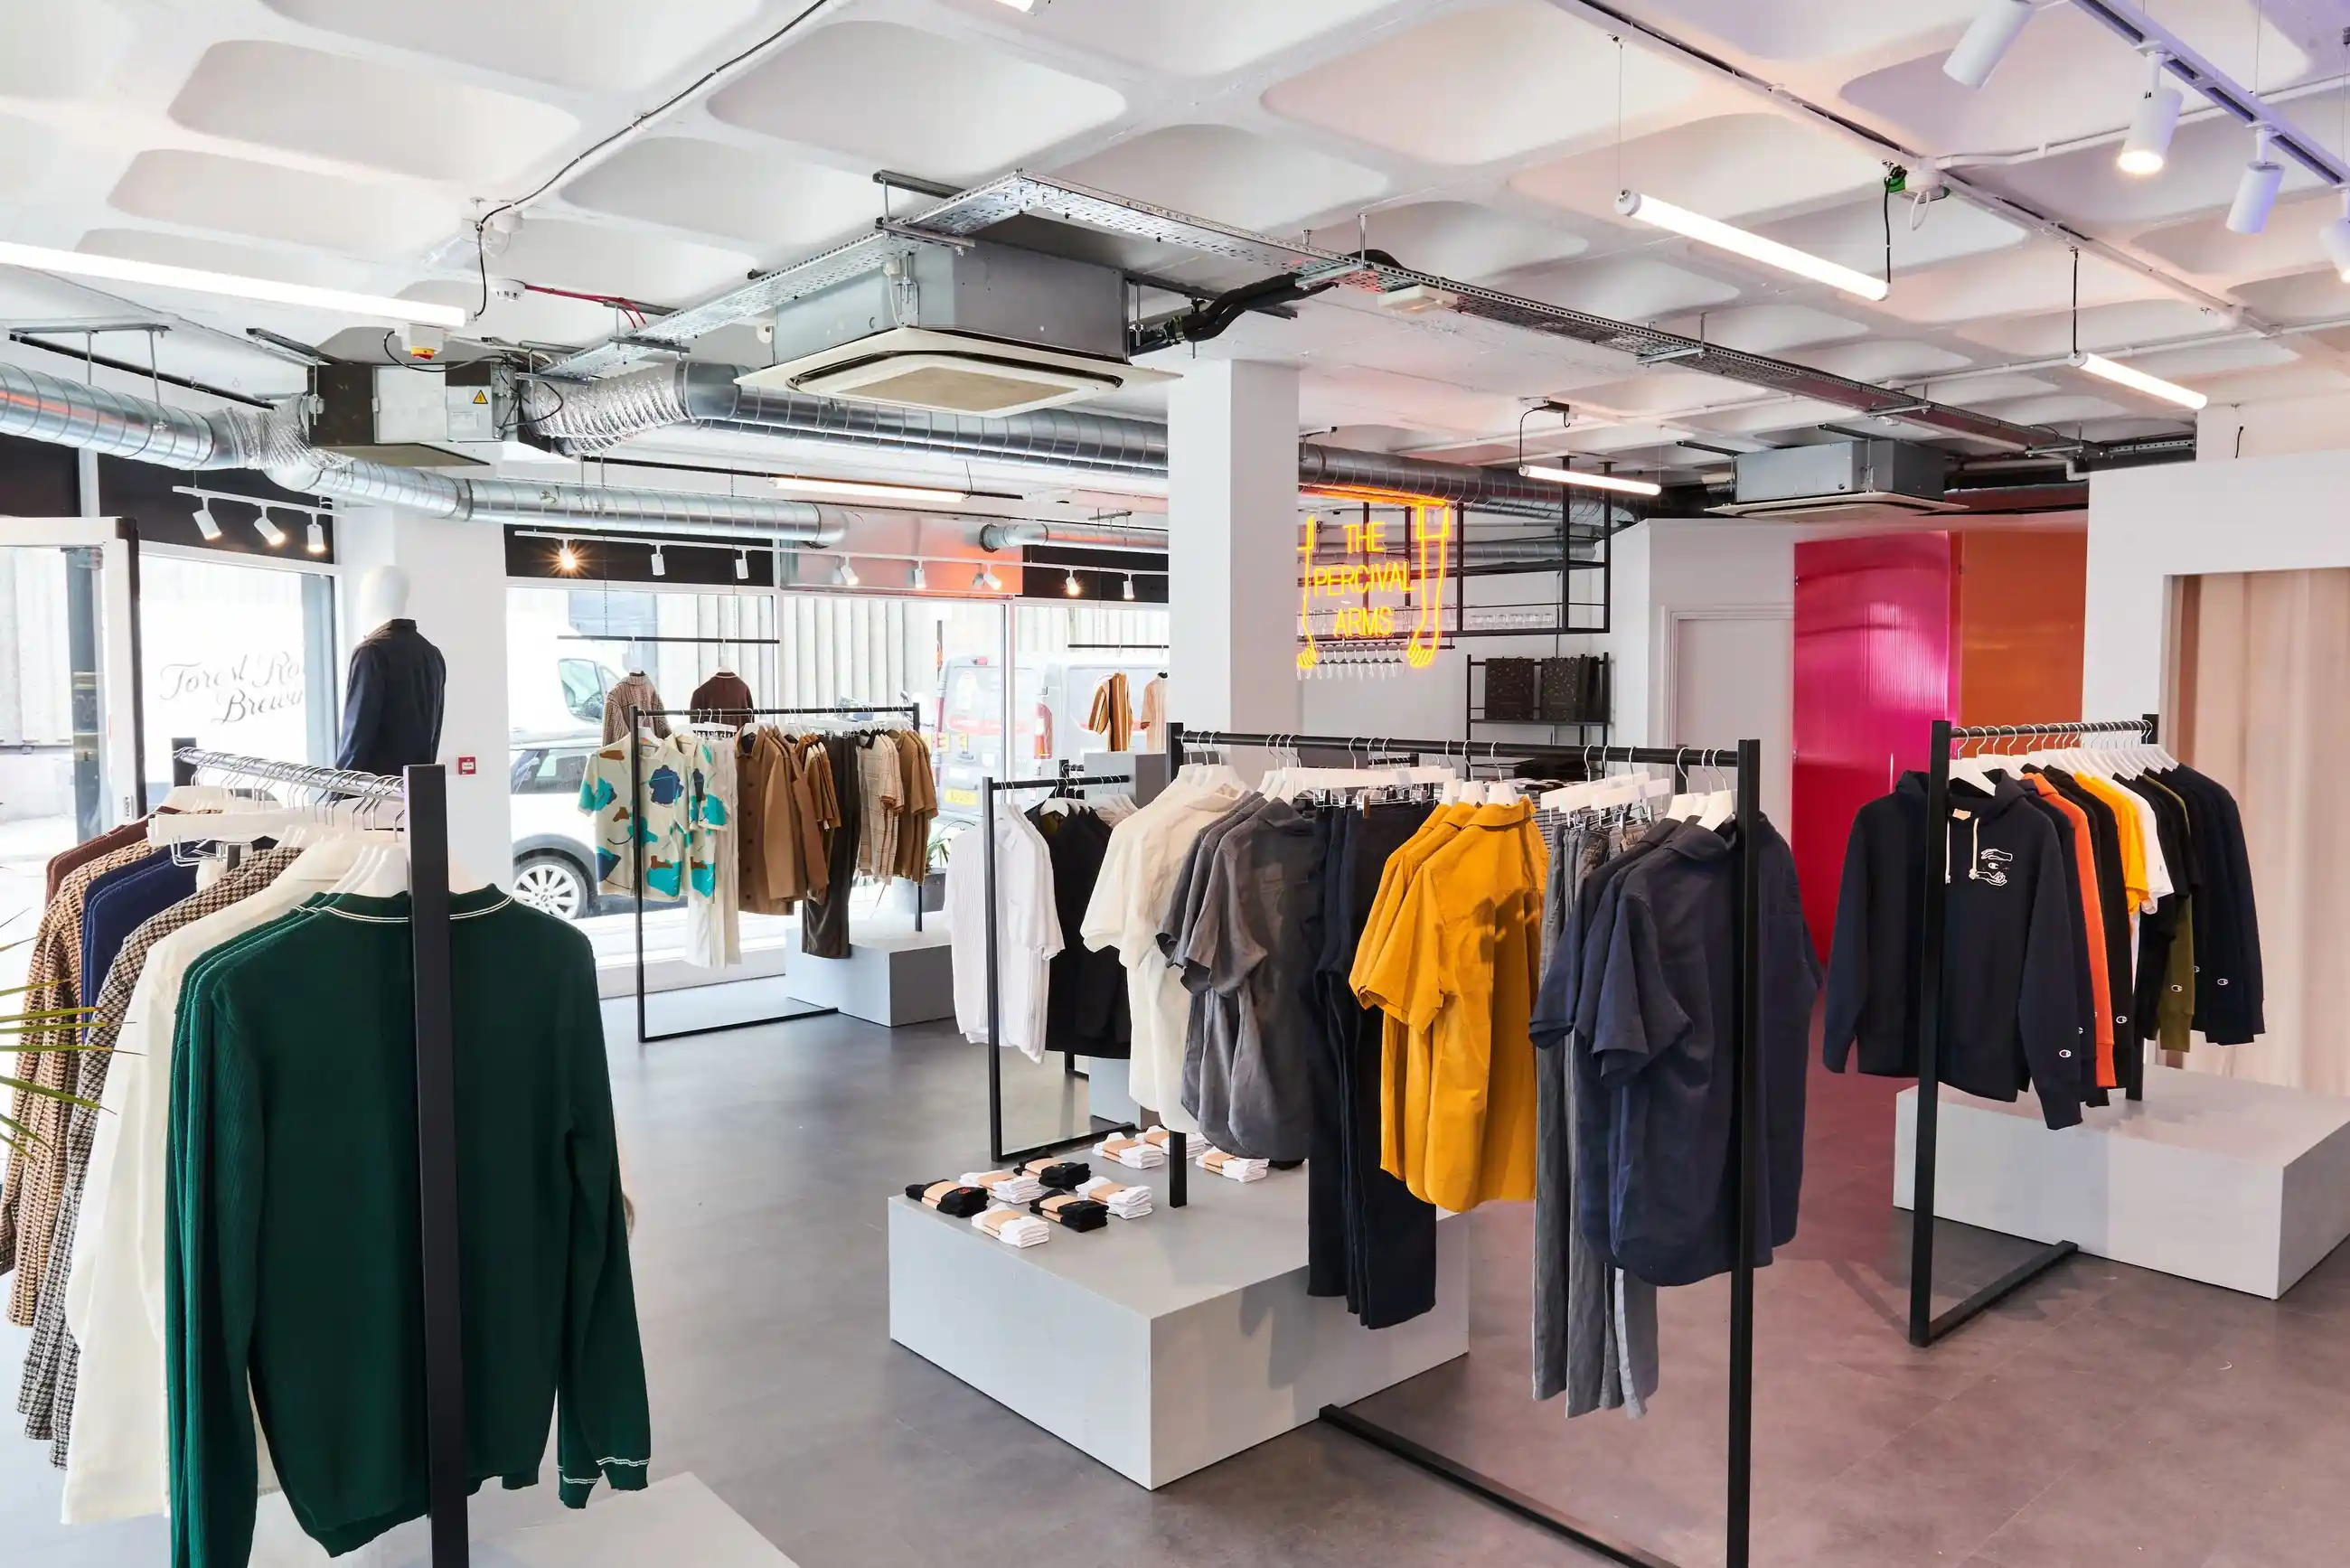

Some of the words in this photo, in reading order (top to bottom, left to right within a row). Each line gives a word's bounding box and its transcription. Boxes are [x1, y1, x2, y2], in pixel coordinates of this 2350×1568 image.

[1343, 522, 1386, 553] THE
[1313, 561, 1416, 596] PERCIVAL
[1333, 607, 1394, 638] ARMS
